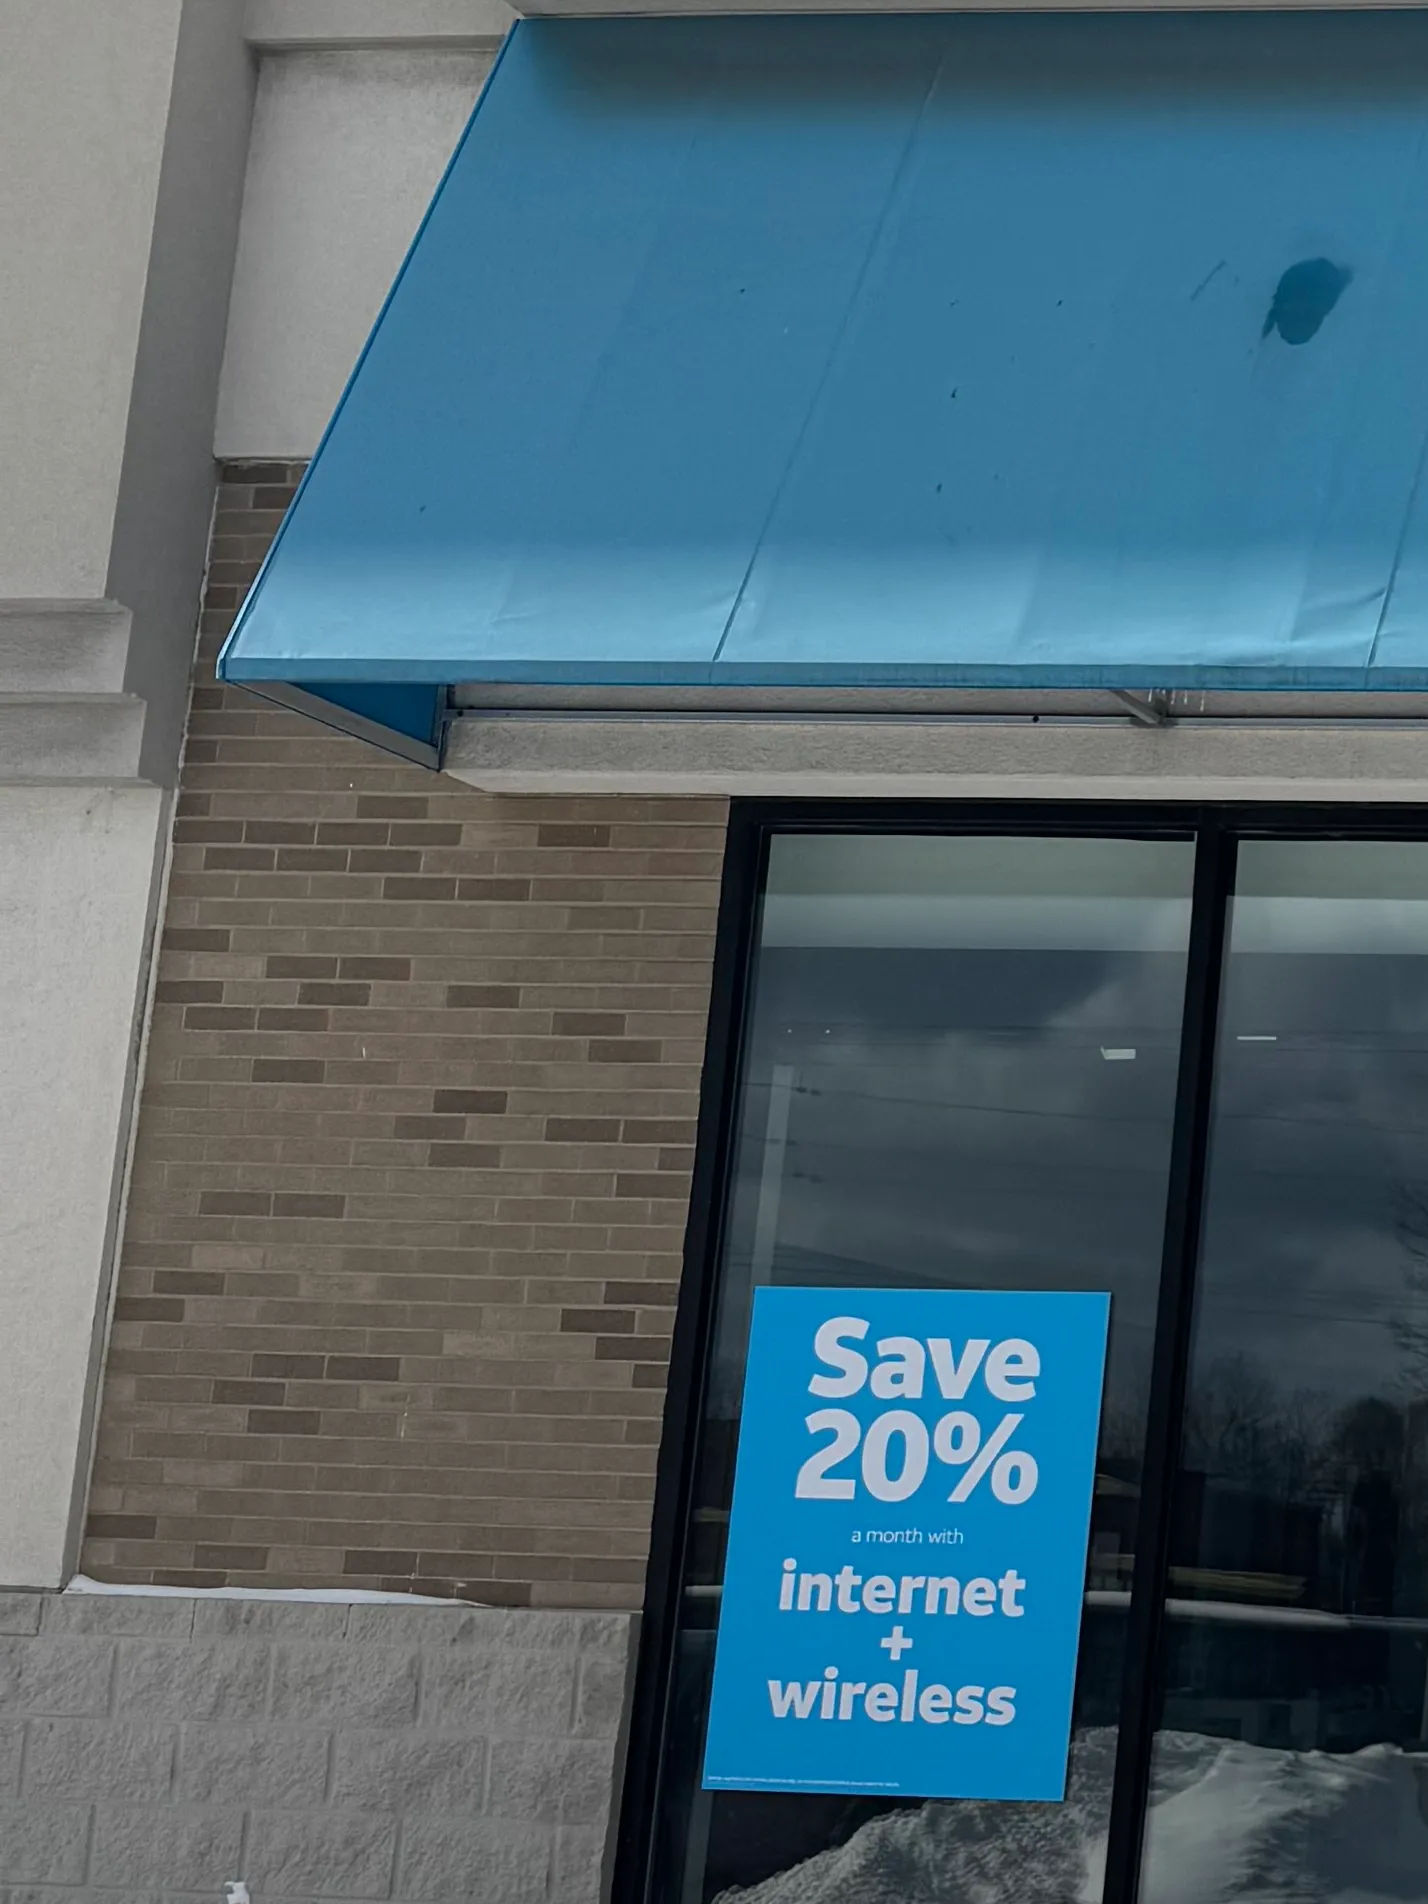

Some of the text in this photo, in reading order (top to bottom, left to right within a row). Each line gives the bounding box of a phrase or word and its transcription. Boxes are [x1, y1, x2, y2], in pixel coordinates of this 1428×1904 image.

[808, 1316, 1041, 1402] Save
[795, 1408, 1039, 1505] 20%
[851, 1527, 964, 1545] a month with
[778, 1557, 1026, 1617] internet
[880, 1625, 913, 1661] +
[767, 1665, 1017, 1726] wireless
